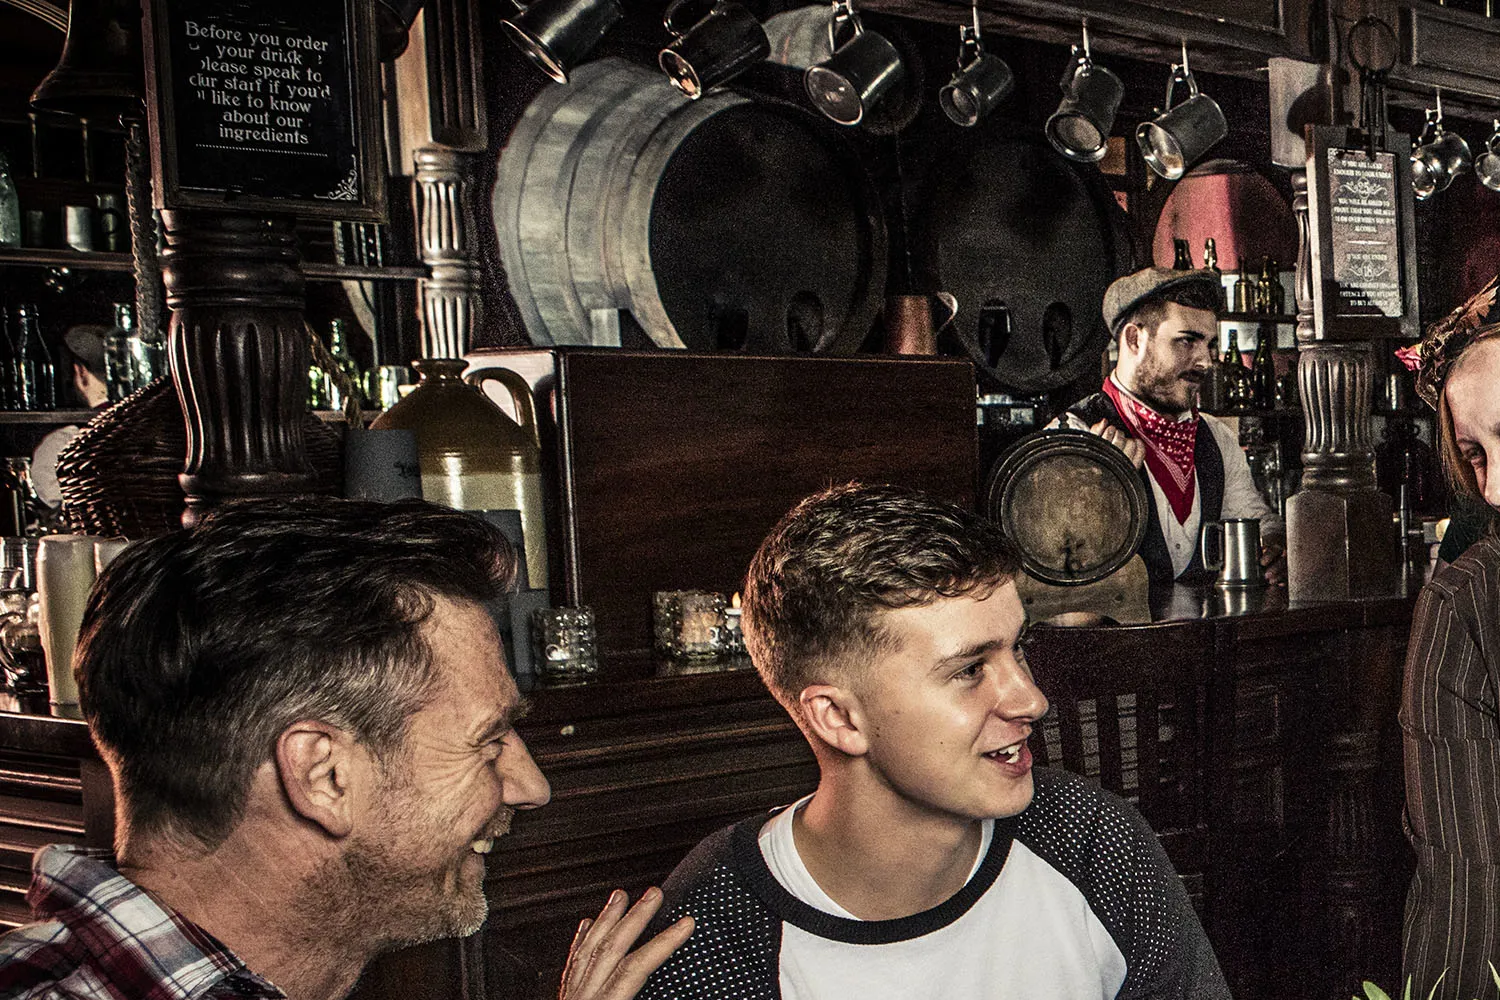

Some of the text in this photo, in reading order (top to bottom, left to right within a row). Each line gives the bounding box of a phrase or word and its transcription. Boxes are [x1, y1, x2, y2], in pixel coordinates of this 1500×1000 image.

[185, 21, 328, 51] Before you order
[216, 45, 255, 59] your
[254, 65, 300, 81] speak
[307, 67, 322, 83] to
[269, 80, 280, 94] if
[212, 90, 311, 113] like to know
[223, 110, 304, 128] about our
[219, 124, 309, 145] ingredients
